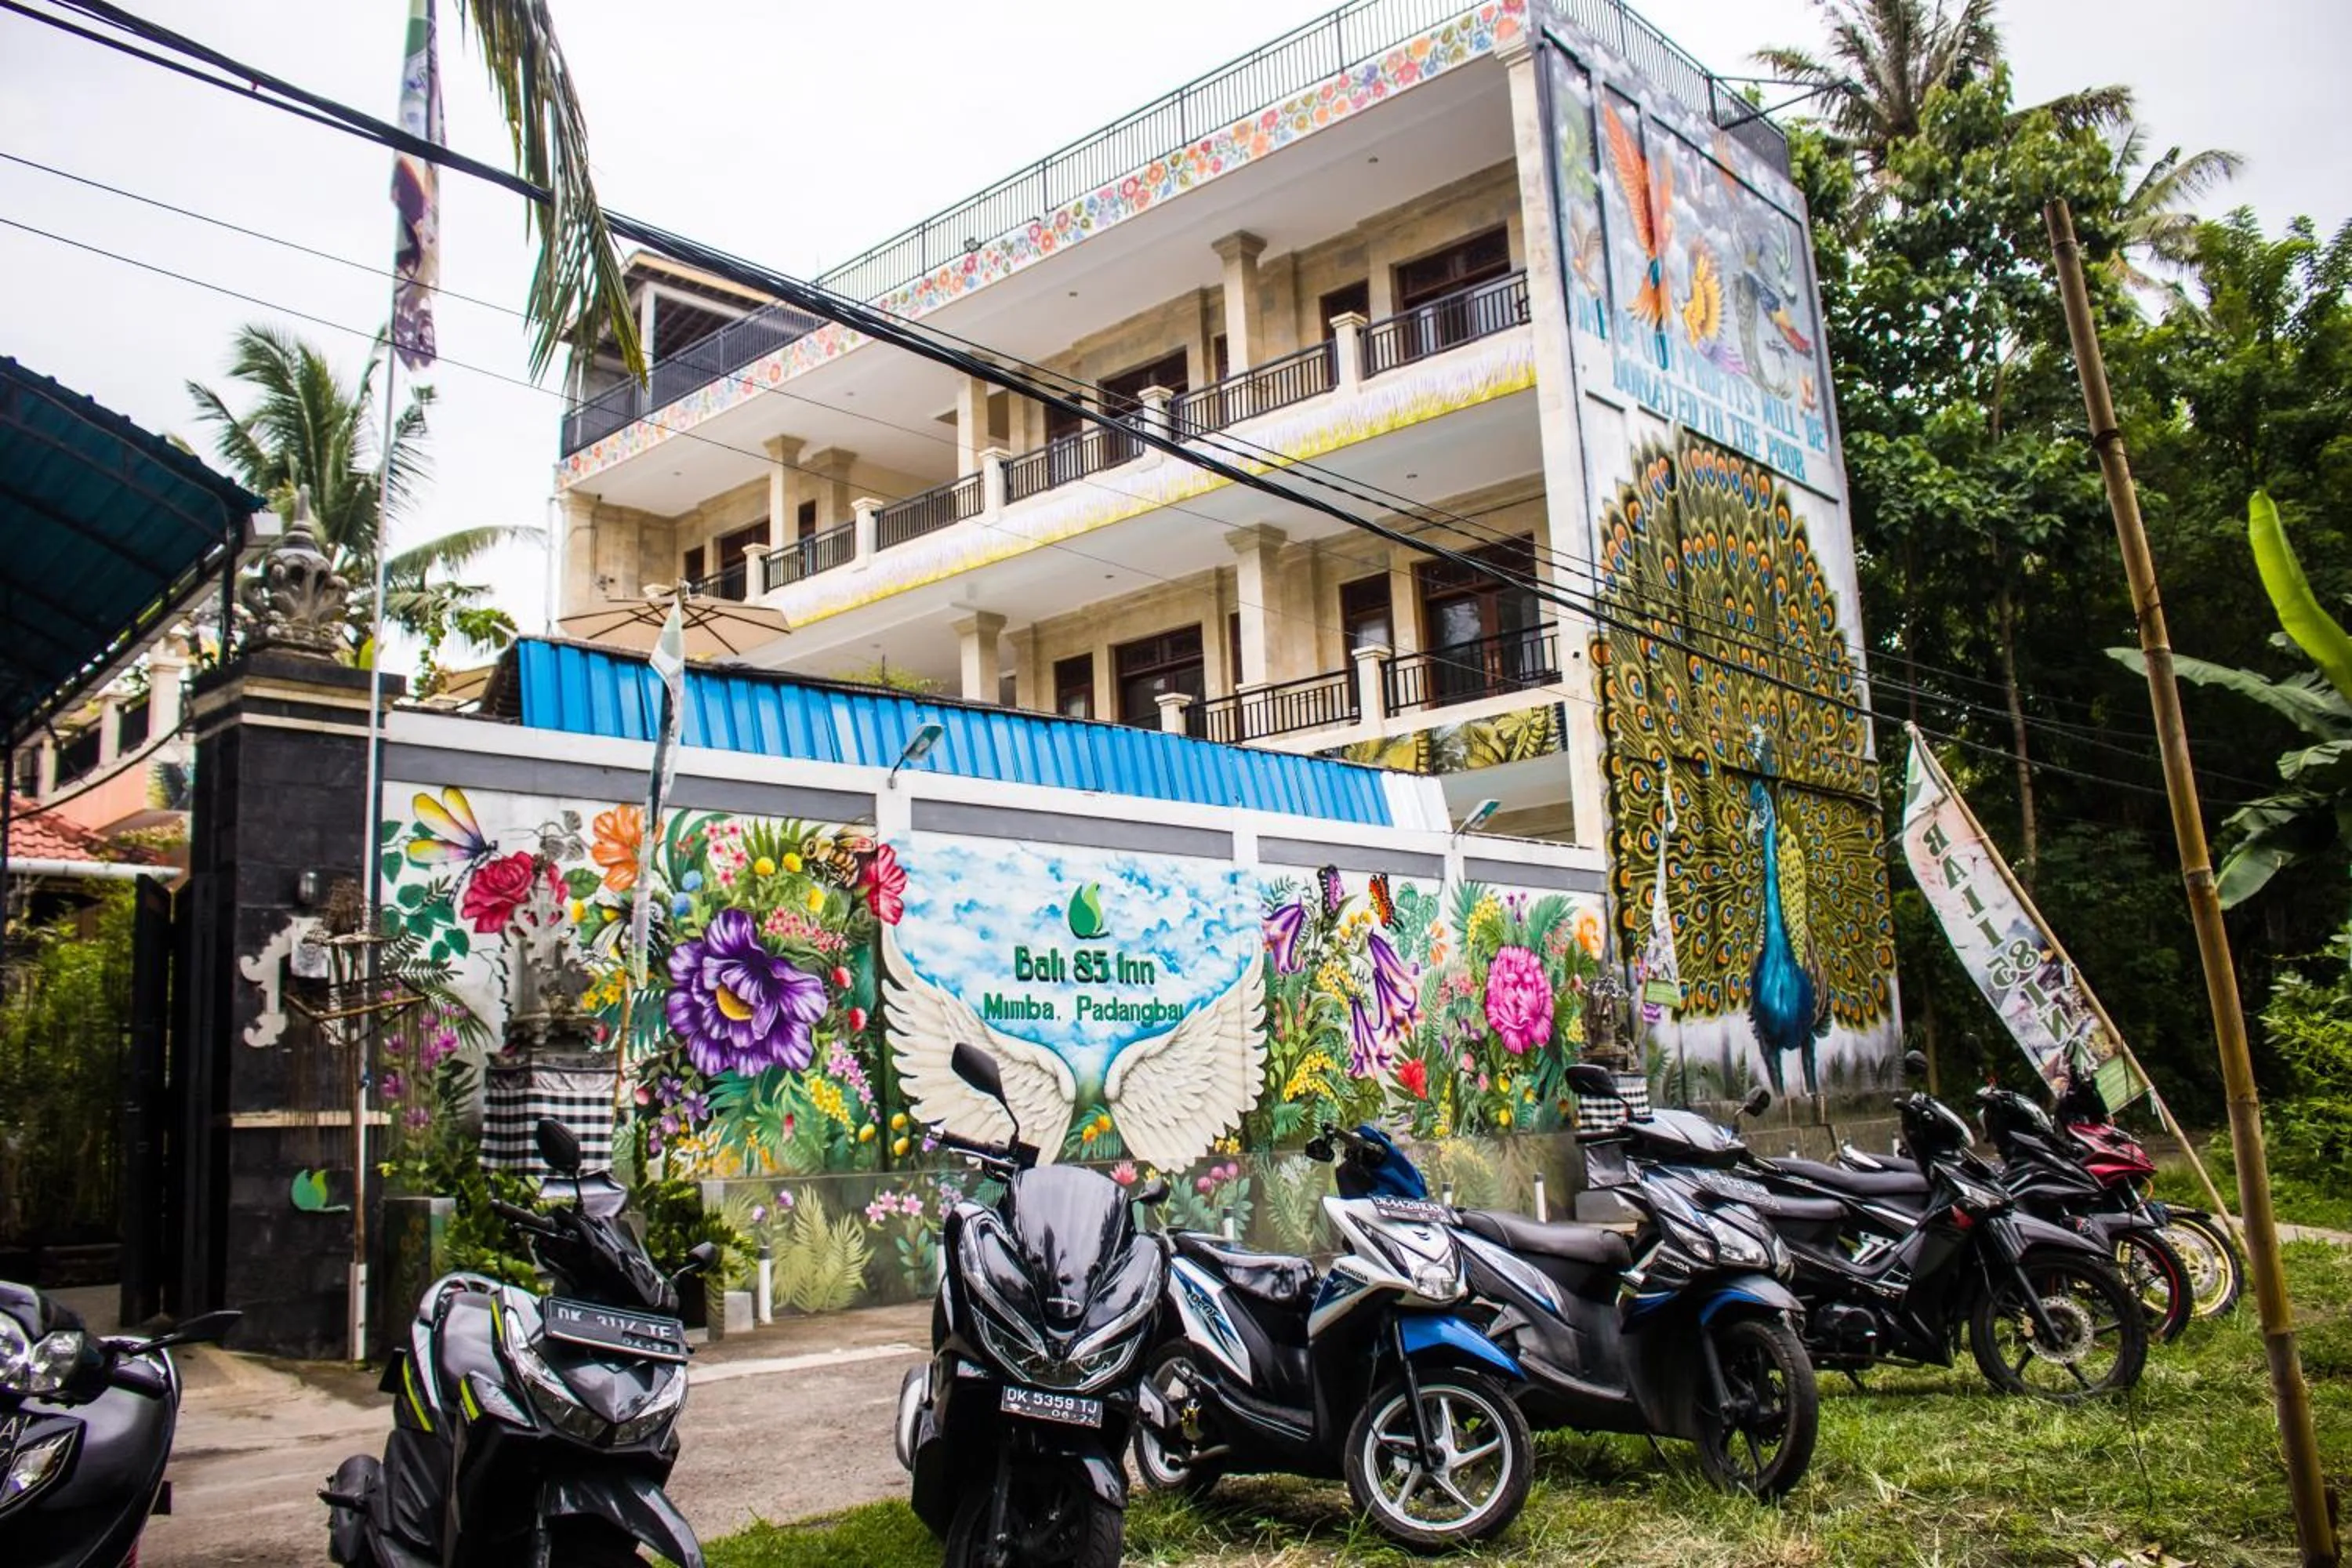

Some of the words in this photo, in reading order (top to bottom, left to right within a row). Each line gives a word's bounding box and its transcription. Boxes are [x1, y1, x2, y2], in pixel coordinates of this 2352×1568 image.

[1613, 354, 1700, 429] DONATED
[1700, 397, 1725, 441] TO
[1727, 412, 1761, 457] THE
[1765, 431, 1806, 483] POOR
[1761, 391, 1799, 439] WILL
[1805, 413, 1826, 452] BE
[1014, 946, 1065, 982] Bali
[1074, 949, 1110, 983] 85
[1117, 951, 1155, 985] Inn
[1076, 994, 1185, 1028] Padangbai
[1007, 1388, 1029, 1403] DK
[1033, 1392, 1075, 1410] 5359
[1080, 1399, 1098, 1414] TJ
